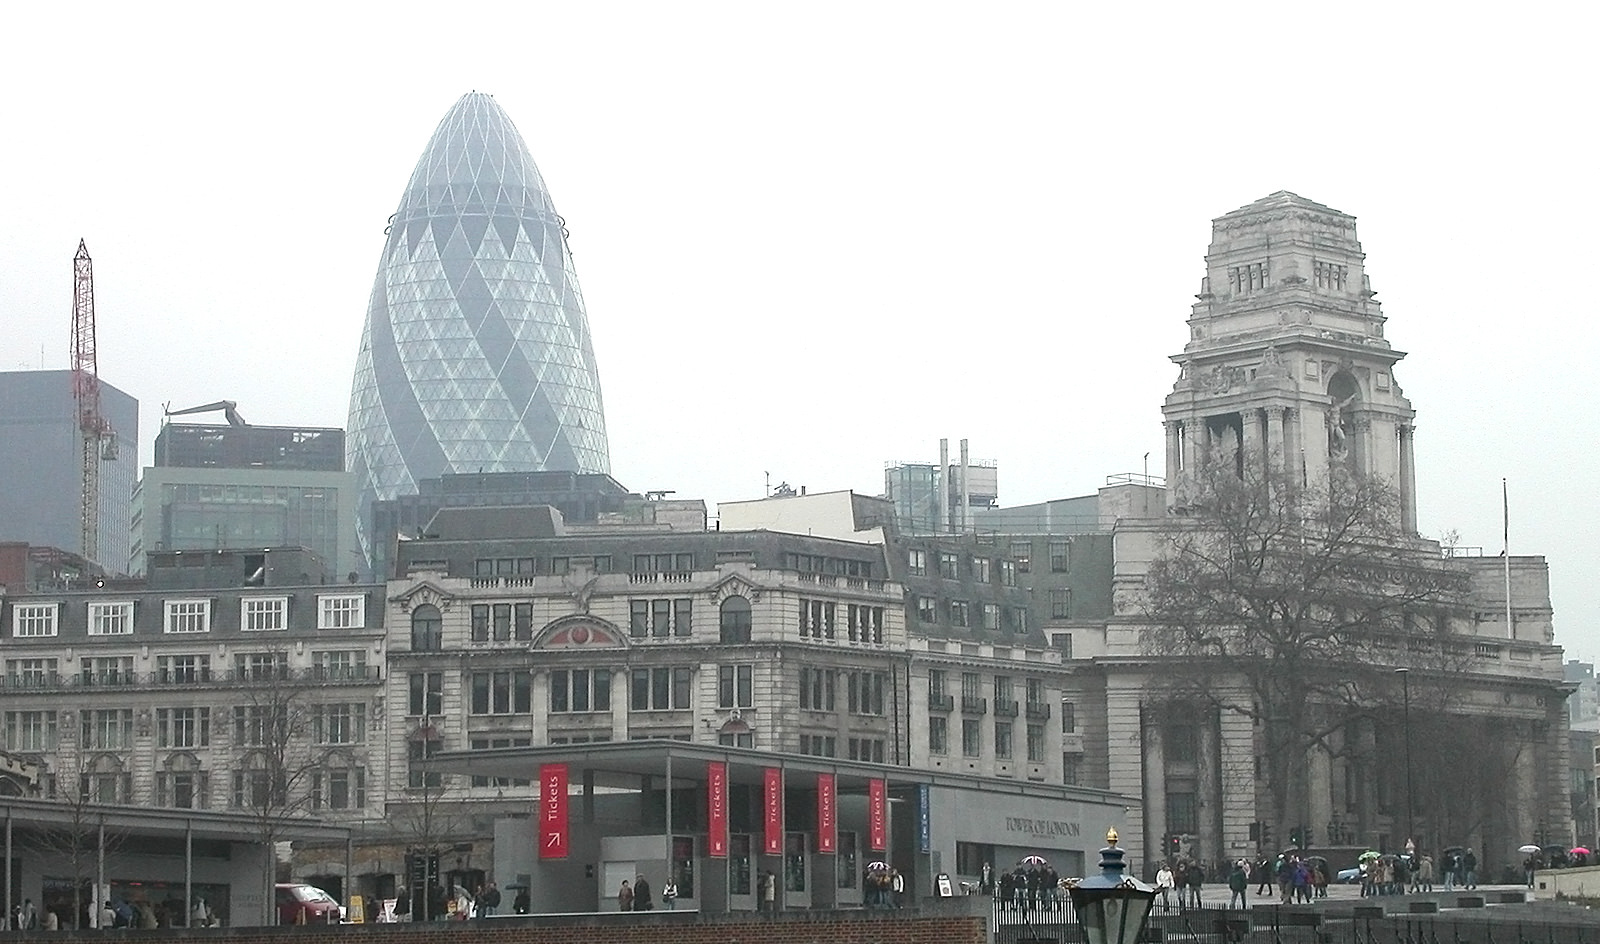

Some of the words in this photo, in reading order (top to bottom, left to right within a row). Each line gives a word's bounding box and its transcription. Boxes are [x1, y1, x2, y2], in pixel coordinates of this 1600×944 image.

[548, 776, 558, 821] Tickets
[1006, 816, 1034, 834] TOWER
[1034, 819, 1045, 834] OF
[1045, 820, 1080, 837] LONDON
